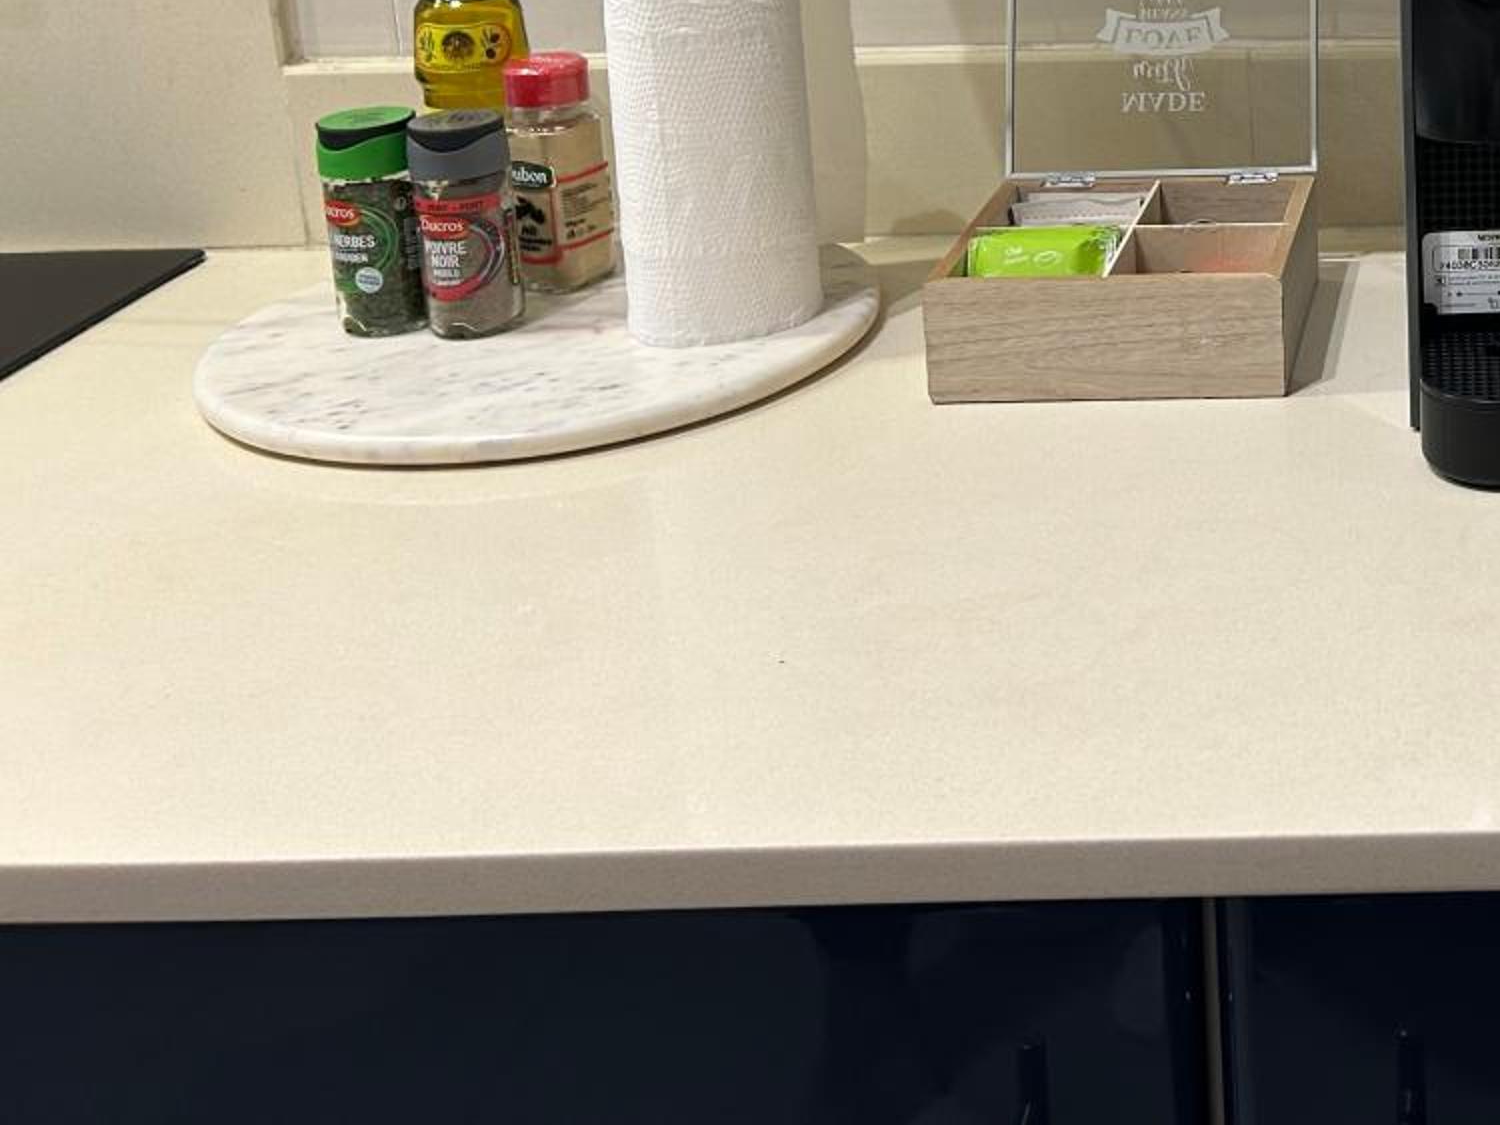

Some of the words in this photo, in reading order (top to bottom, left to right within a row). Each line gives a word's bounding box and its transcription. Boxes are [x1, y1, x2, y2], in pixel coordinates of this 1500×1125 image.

[511, 166, 547, 185] ubon
[420, 218, 465, 232] Ducros
[431, 254, 461, 268] NOIR
